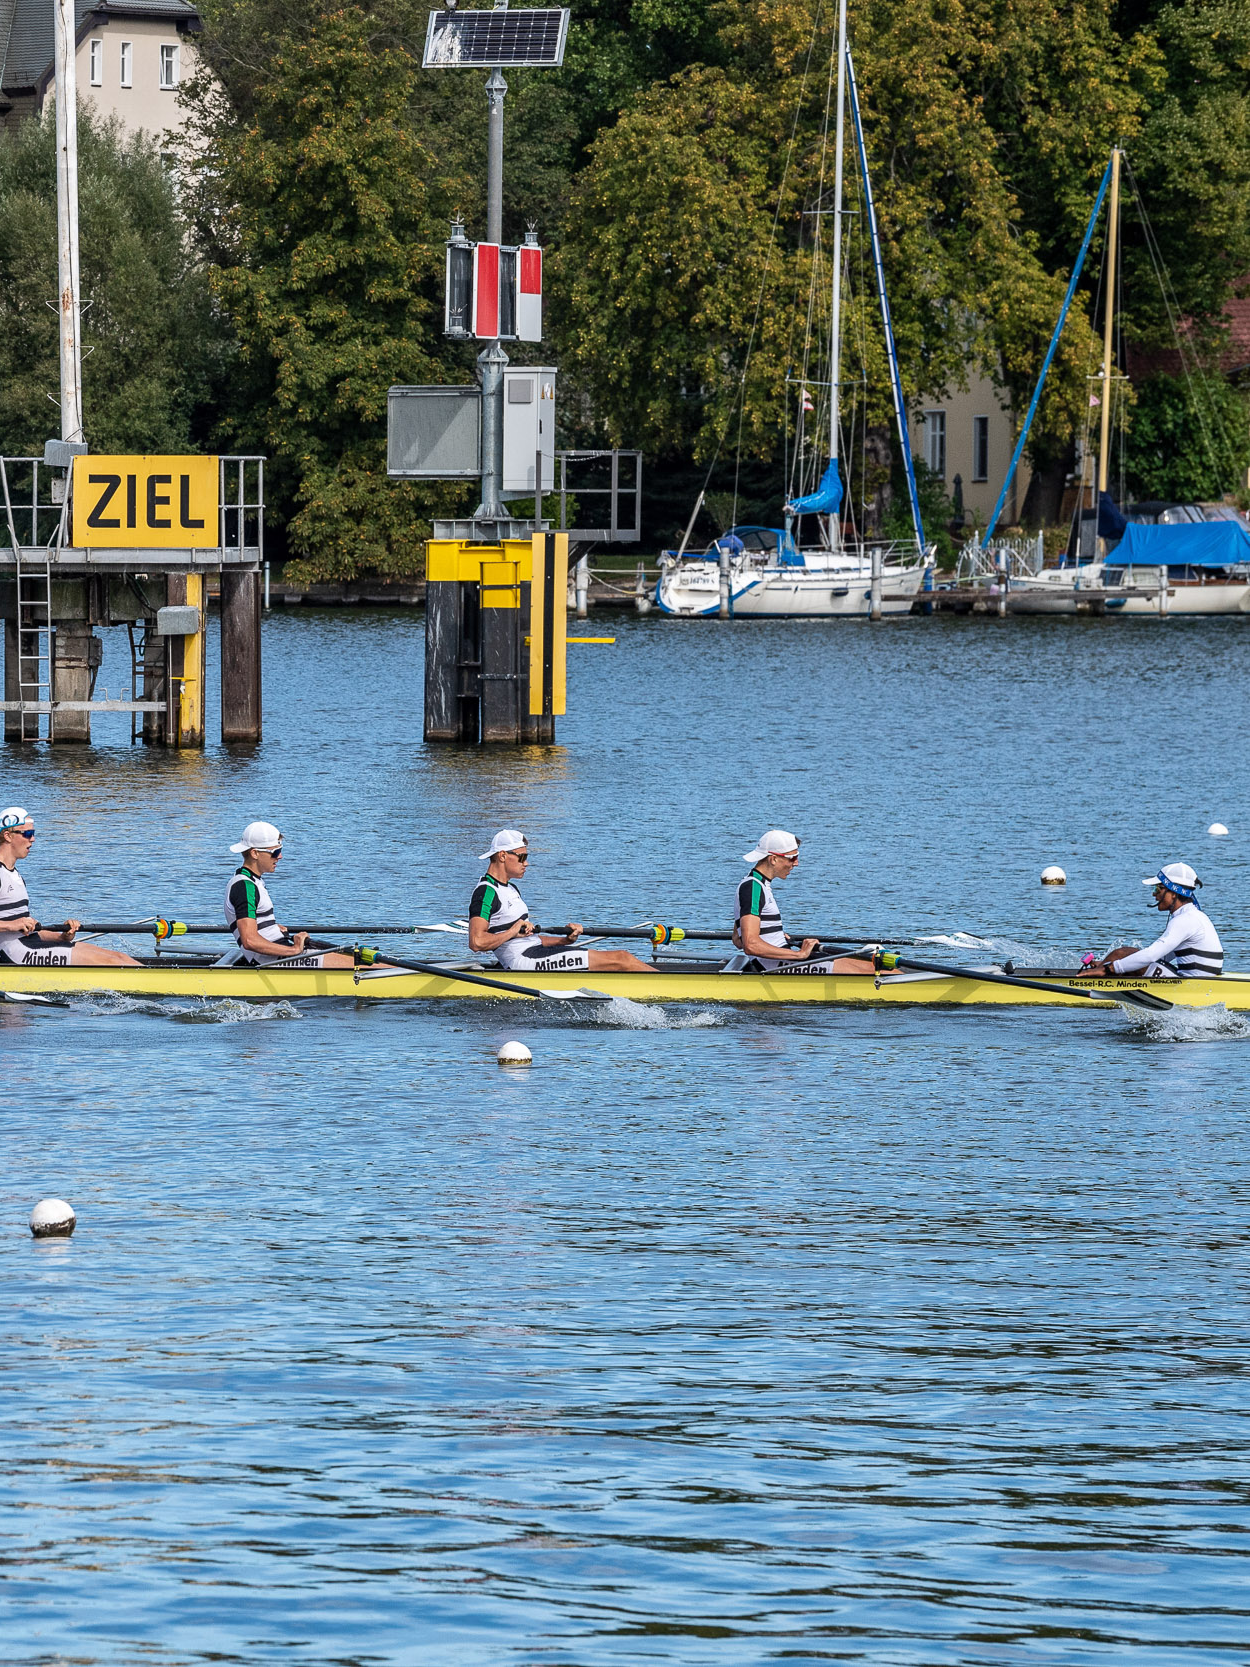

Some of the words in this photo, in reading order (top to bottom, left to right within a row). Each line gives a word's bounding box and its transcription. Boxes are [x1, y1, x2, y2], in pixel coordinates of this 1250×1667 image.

[87, 474, 205, 529] ZIEL
[21, 951, 67, 965] Minden
[535, 955, 583, 970] Minden
